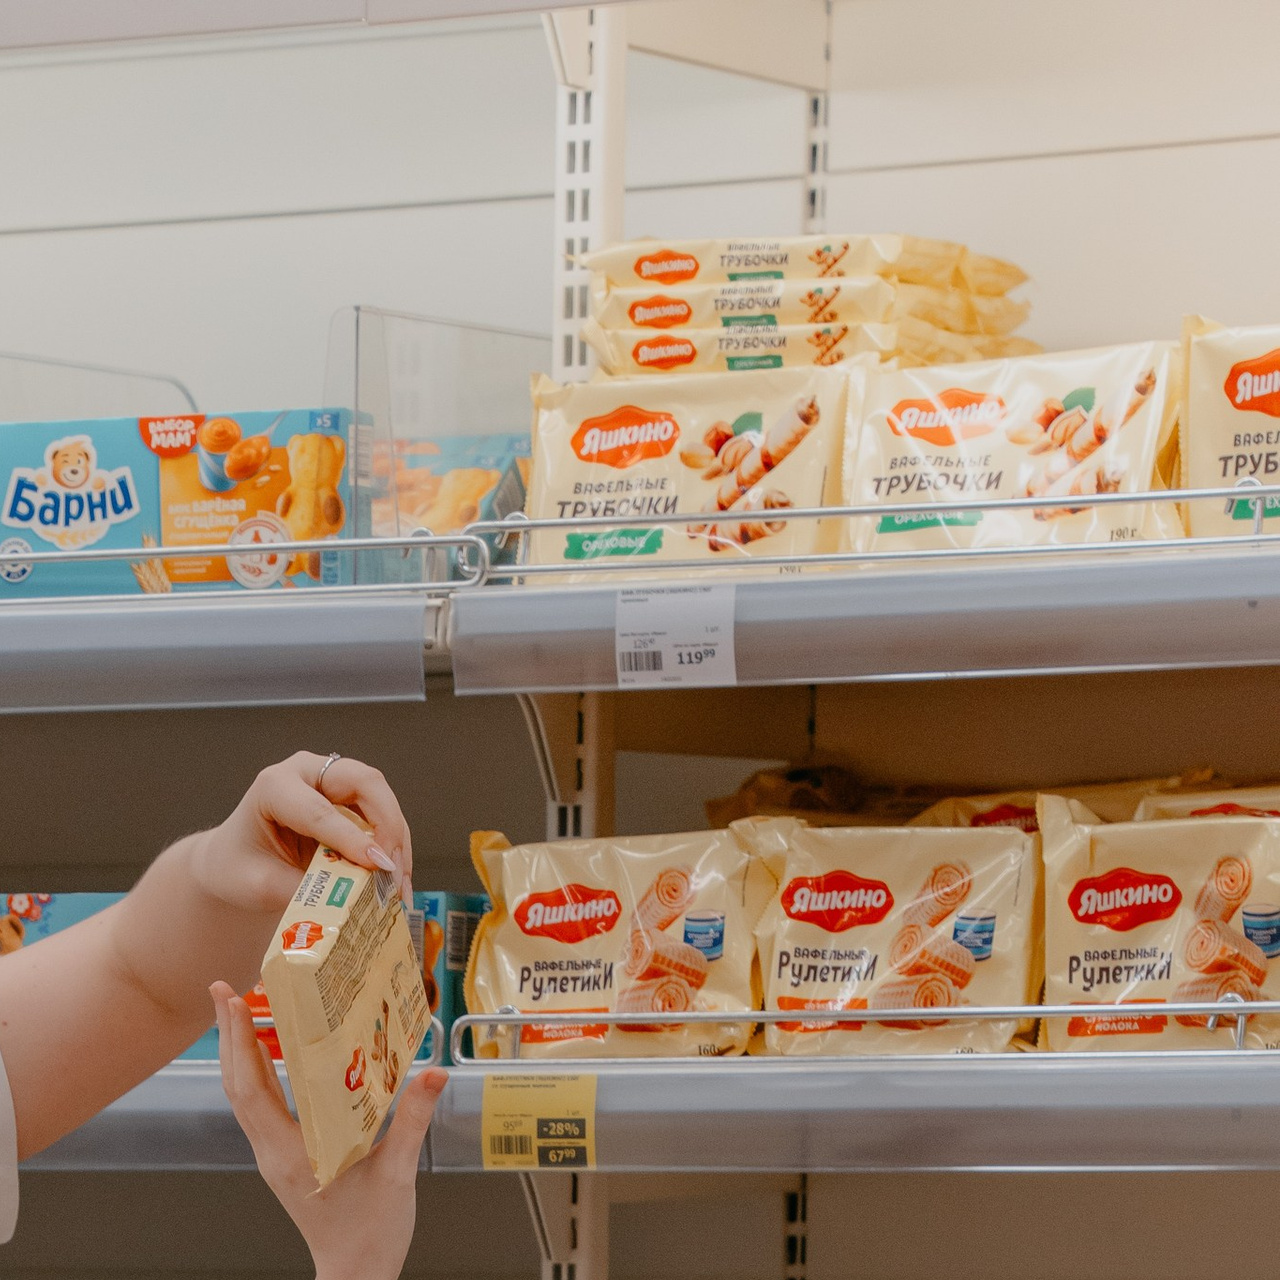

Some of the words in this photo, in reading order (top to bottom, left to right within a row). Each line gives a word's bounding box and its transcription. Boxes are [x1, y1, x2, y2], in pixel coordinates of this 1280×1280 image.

[719, 253, 789, 268] ТРУБОЧКИ
[713, 296, 782, 311] ТРУБОЧКИ
[718, 336, 787, 351] ТРУБОЧКИ
[573, 477, 669, 496] ВАФЕЛЬНЫЕ
[872, 471, 1003, 497] ТРУБОЧКИ
[9, 476, 134, 527] Барни
[791, 888, 887, 912] Яшкино
[1079, 883, 1173, 916] Яшкино
[526, 897, 616, 930] Яшкино
[794, 947, 867, 962] ВАФЕЛЬНЫЕ
[1084, 948, 1159, 961] ВАФЕЛЬНЫЕ
[534, 959, 603, 972] ВАФЕЛЬНЫЕ
[778, 950, 878, 988] Рулетики
[520, 963, 613, 1000] Рулетики
[543, 1122, 580, 1135] -28%
